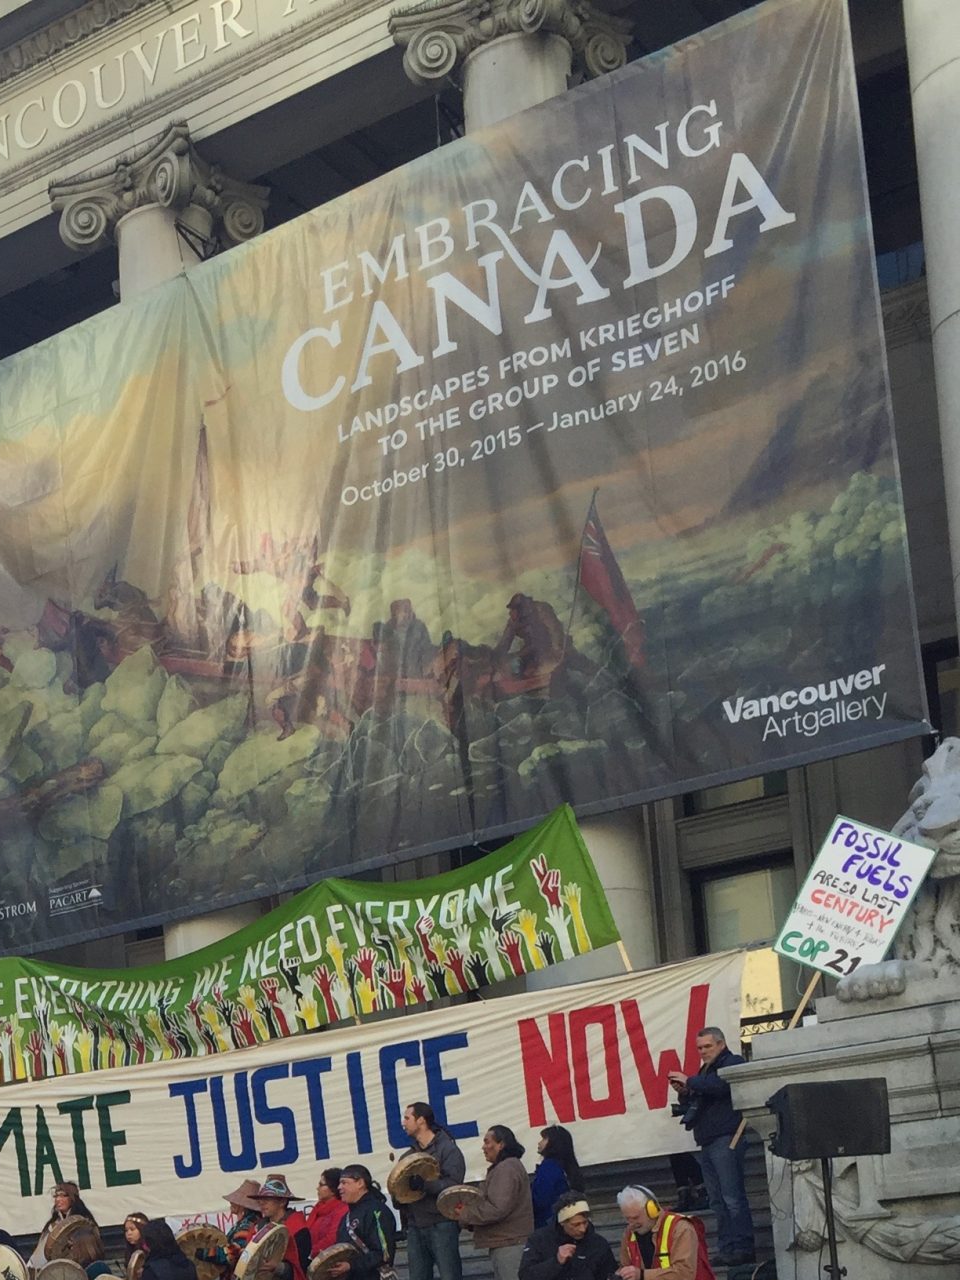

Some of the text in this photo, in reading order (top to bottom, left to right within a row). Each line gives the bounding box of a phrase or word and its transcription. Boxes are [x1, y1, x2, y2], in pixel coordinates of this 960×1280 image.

[320, 100, 724, 313] EMBRACING
[281, 152, 796, 412] CANADA
[337, 274, 736, 442] LANDSCAPES FROM KRIEGHOFF
[378, 323, 701, 457] TO THE GROUP OF SEVEN
[340, 463, 430, 507] October
[434, 446, 465, 474] 30,
[471, 424, 522, 462] 2015
[547, 389, 644, 433] January
[649, 376, 684, 402] 24,
[690, 351, 748, 388] 2016
[721, 662, 887, 726] Vancouver
[761, 691, 889, 743] Artgallery
[831, 822, 902, 868] FOSSIL
[842, 854, 912, 899] FUELS
[49, 890, 88, 910] PACART
[810, 889, 895, 934] CENTURY
[813, 870, 901, 915] ARE SO LAST
[14, 974, 185, 1020] EVERYTHING
[192, 953, 235, 999] WE
[239, 914, 322, 984] NEED
[326, 864, 522, 950] EVERYONE
[780, 931, 862, 976] COP 21
[168, 983, 710, 1180] JUSTICE NOW
